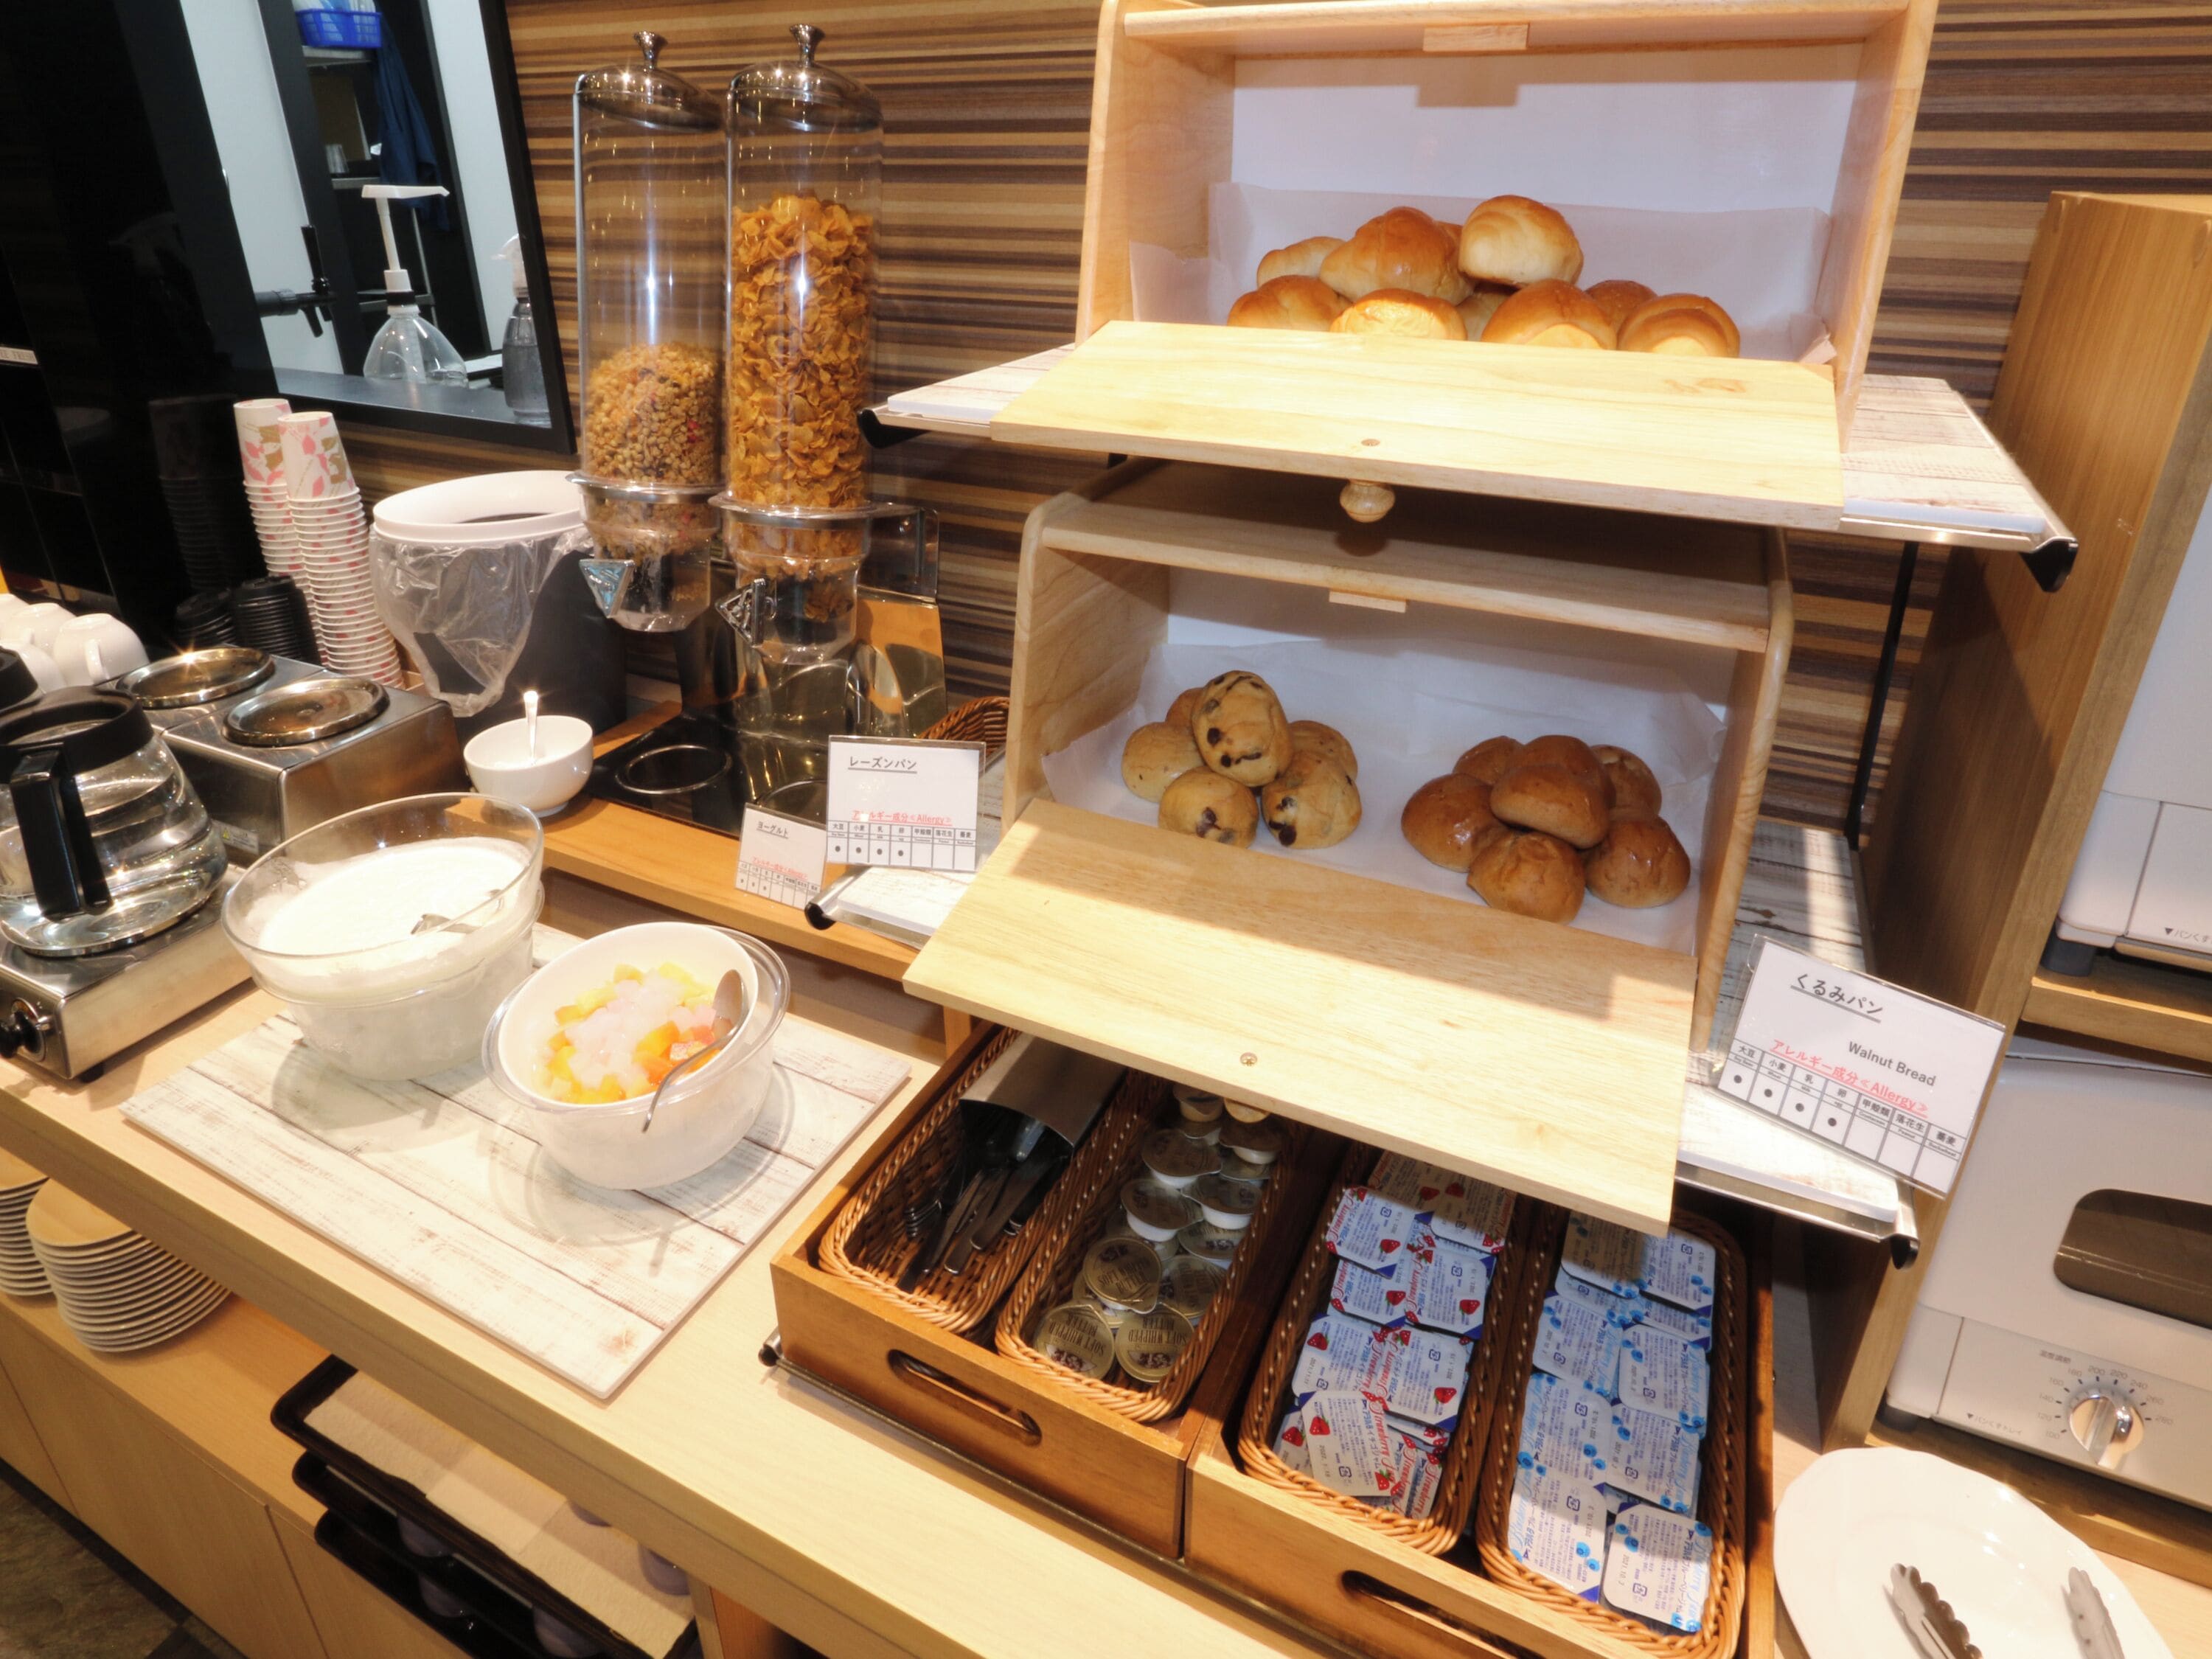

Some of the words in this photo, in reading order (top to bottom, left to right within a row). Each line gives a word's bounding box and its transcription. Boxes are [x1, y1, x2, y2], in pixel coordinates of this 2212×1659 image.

[850, 756, 917, 769] レーズンパン
[757, 821, 788, 837] ヨーグルト
[1796, 973, 1883, 1015] くるみパン
[1849, 1041, 1893, 1069] Walnut
[1897, 1061, 1936, 1087] Bread
[1739, 1046, 1756, 1058] 大豆
[1770, 1060, 1787, 1072] 小麦
[1805, 1074, 1813, 1084] 乳
[1896, 1113, 1924, 1133] 落花生
[1049, 1322, 1082, 1346] WHIPPED
[1129, 1330, 1164, 1344] WHIPPED
[1082, 1337, 1105, 1357] SOFT
[2088, 1365, 2105, 1376] 200
[2110, 1368, 2128, 1380] 220
[2130, 1380, 2148, 1390] 240
